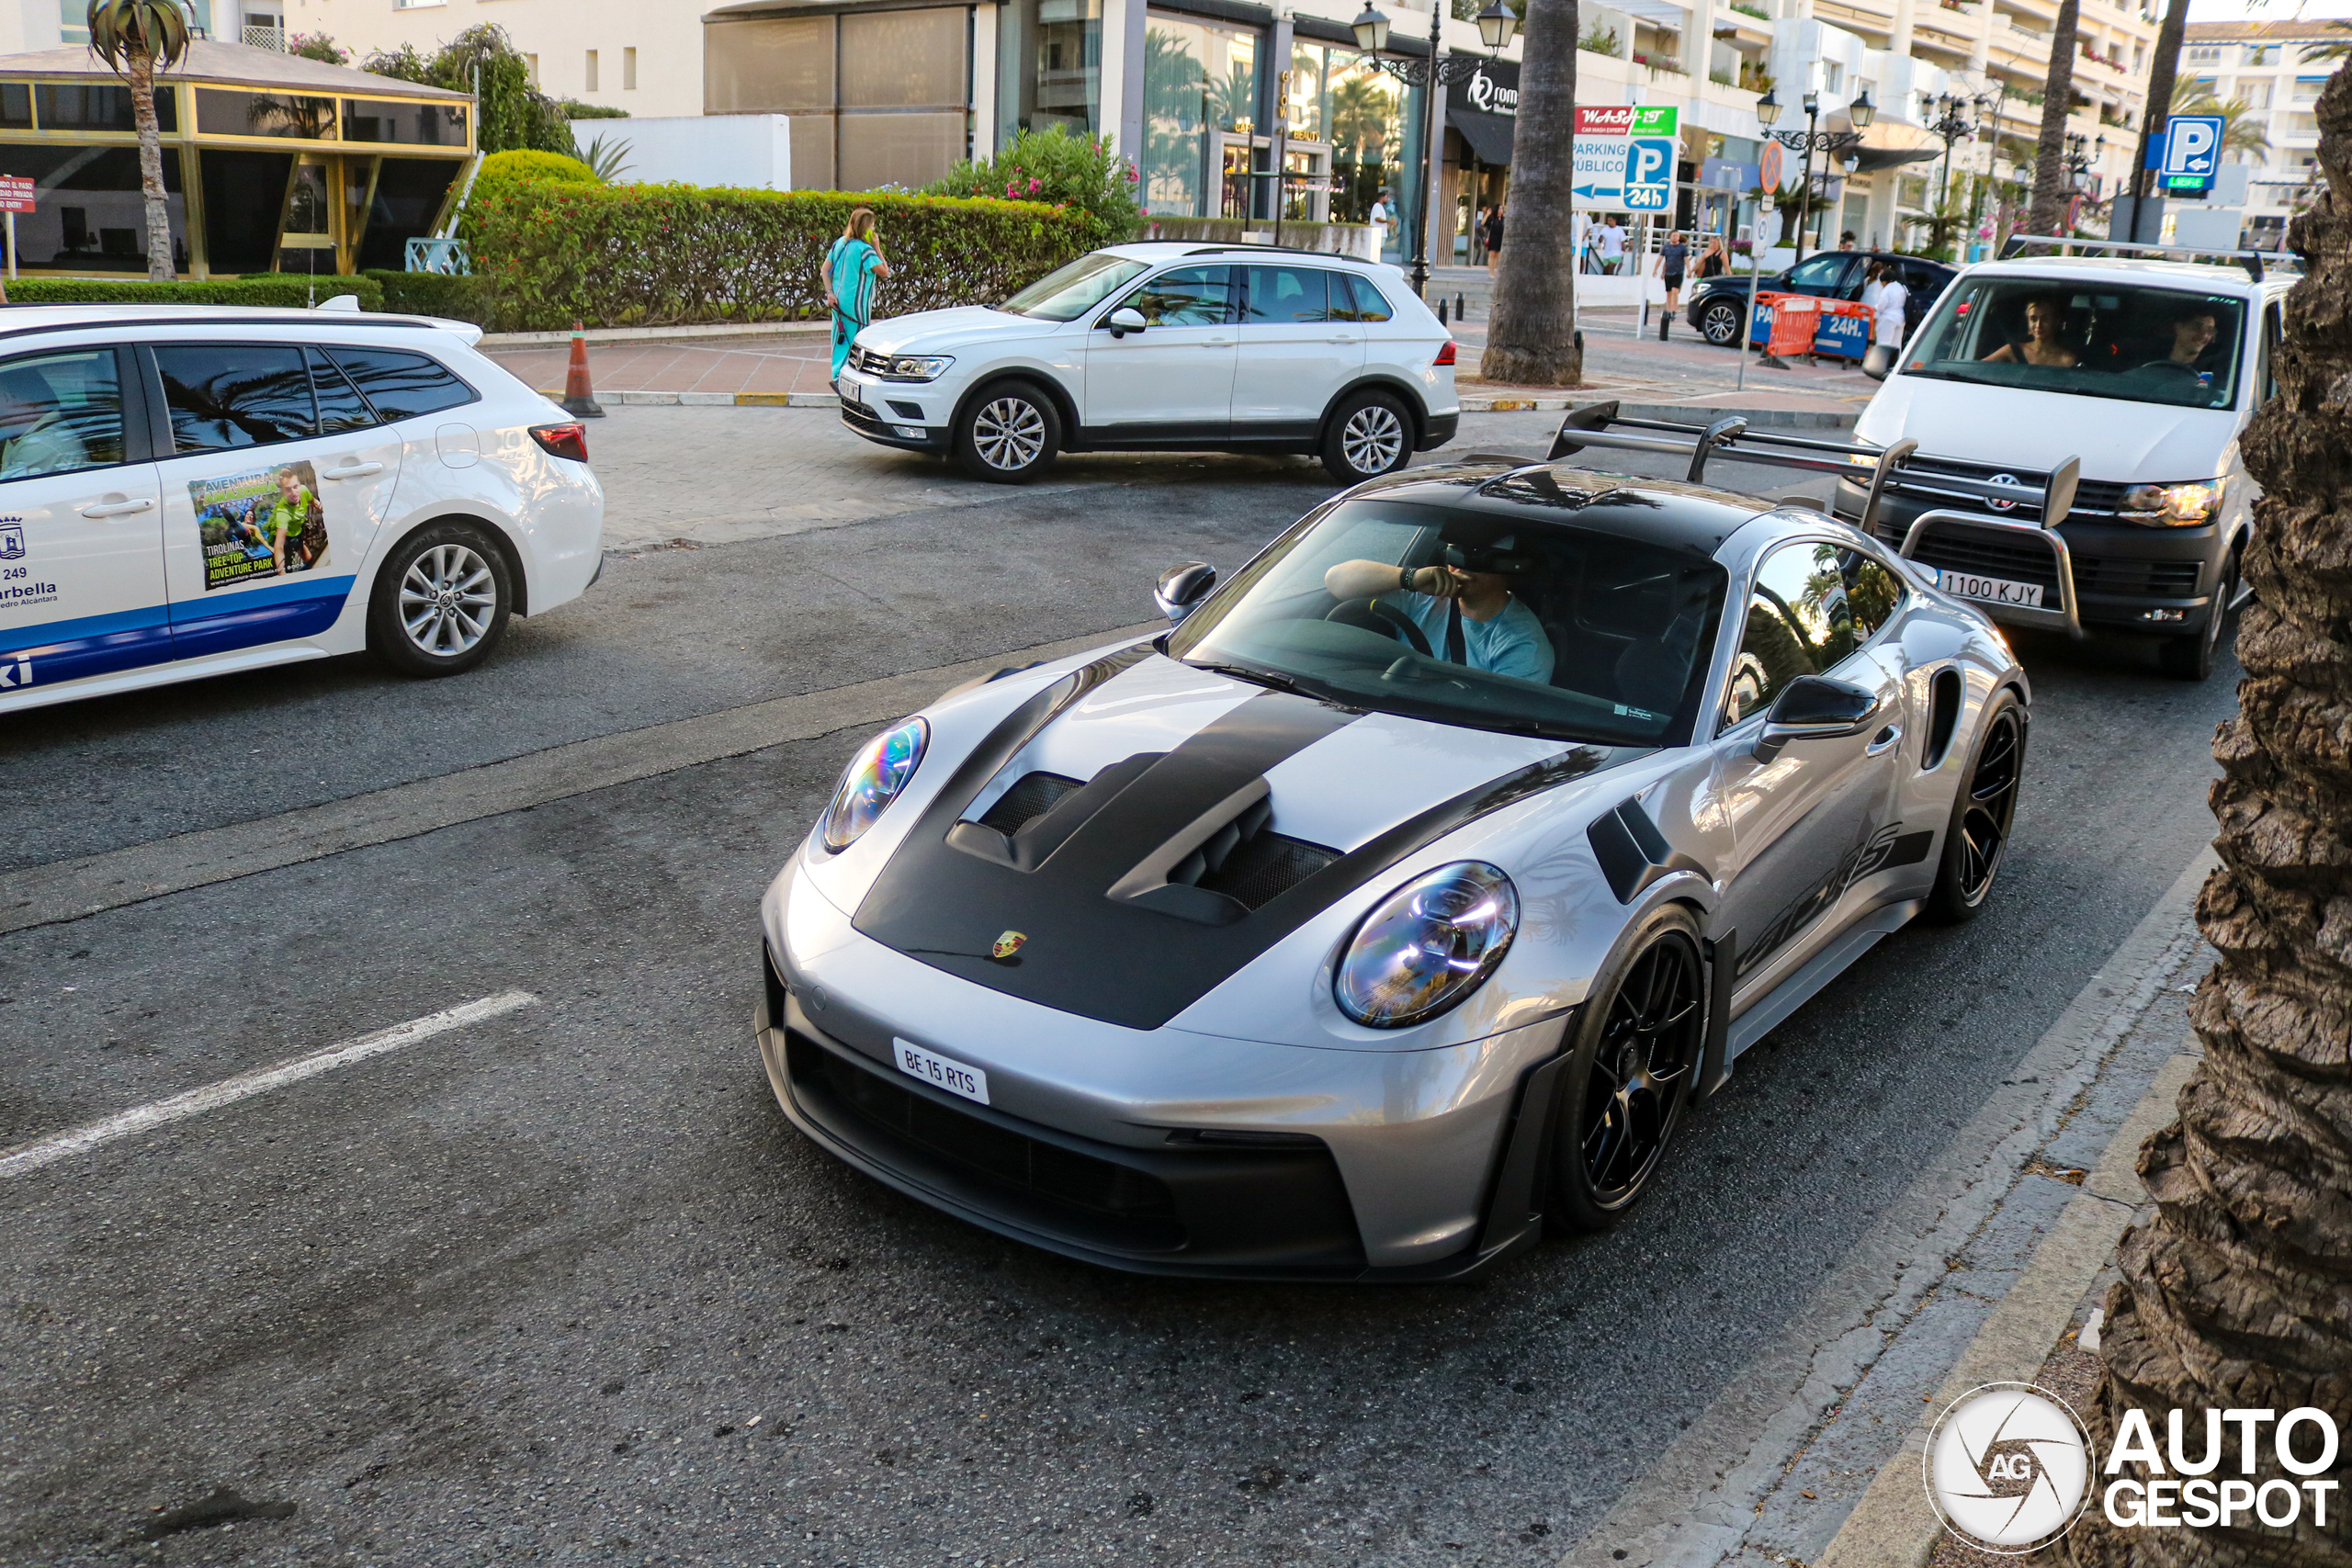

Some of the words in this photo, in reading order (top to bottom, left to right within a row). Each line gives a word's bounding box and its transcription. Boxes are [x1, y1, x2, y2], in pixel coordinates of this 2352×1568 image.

[1582, 108, 1642, 125] WASH
[2169, 122, 2214, 172] P
[1635, 147, 1663, 184] P
[2168, 176, 2202, 188] LIBRE
[1630, 188, 1662, 206] 24h
[206, 472, 272, 492] AVENTURA
[207, 539, 244, 557] TIROLINAS
[209, 552, 243, 569] TREE-TOP
[209, 564, 253, 580] ADVENTURE
[254, 558, 273, 570] PARK
[3, 567, 27, 580] 249
[1947, 574, 1992, 597] 1100
[1998, 582, 2037, 604] KJY
[21, 595, 58, 605] Alcántara
[905, 1049, 923, 1074] BE
[925, 1059, 942, 1081] 15
[945, 1066, 976, 1093] RTS
